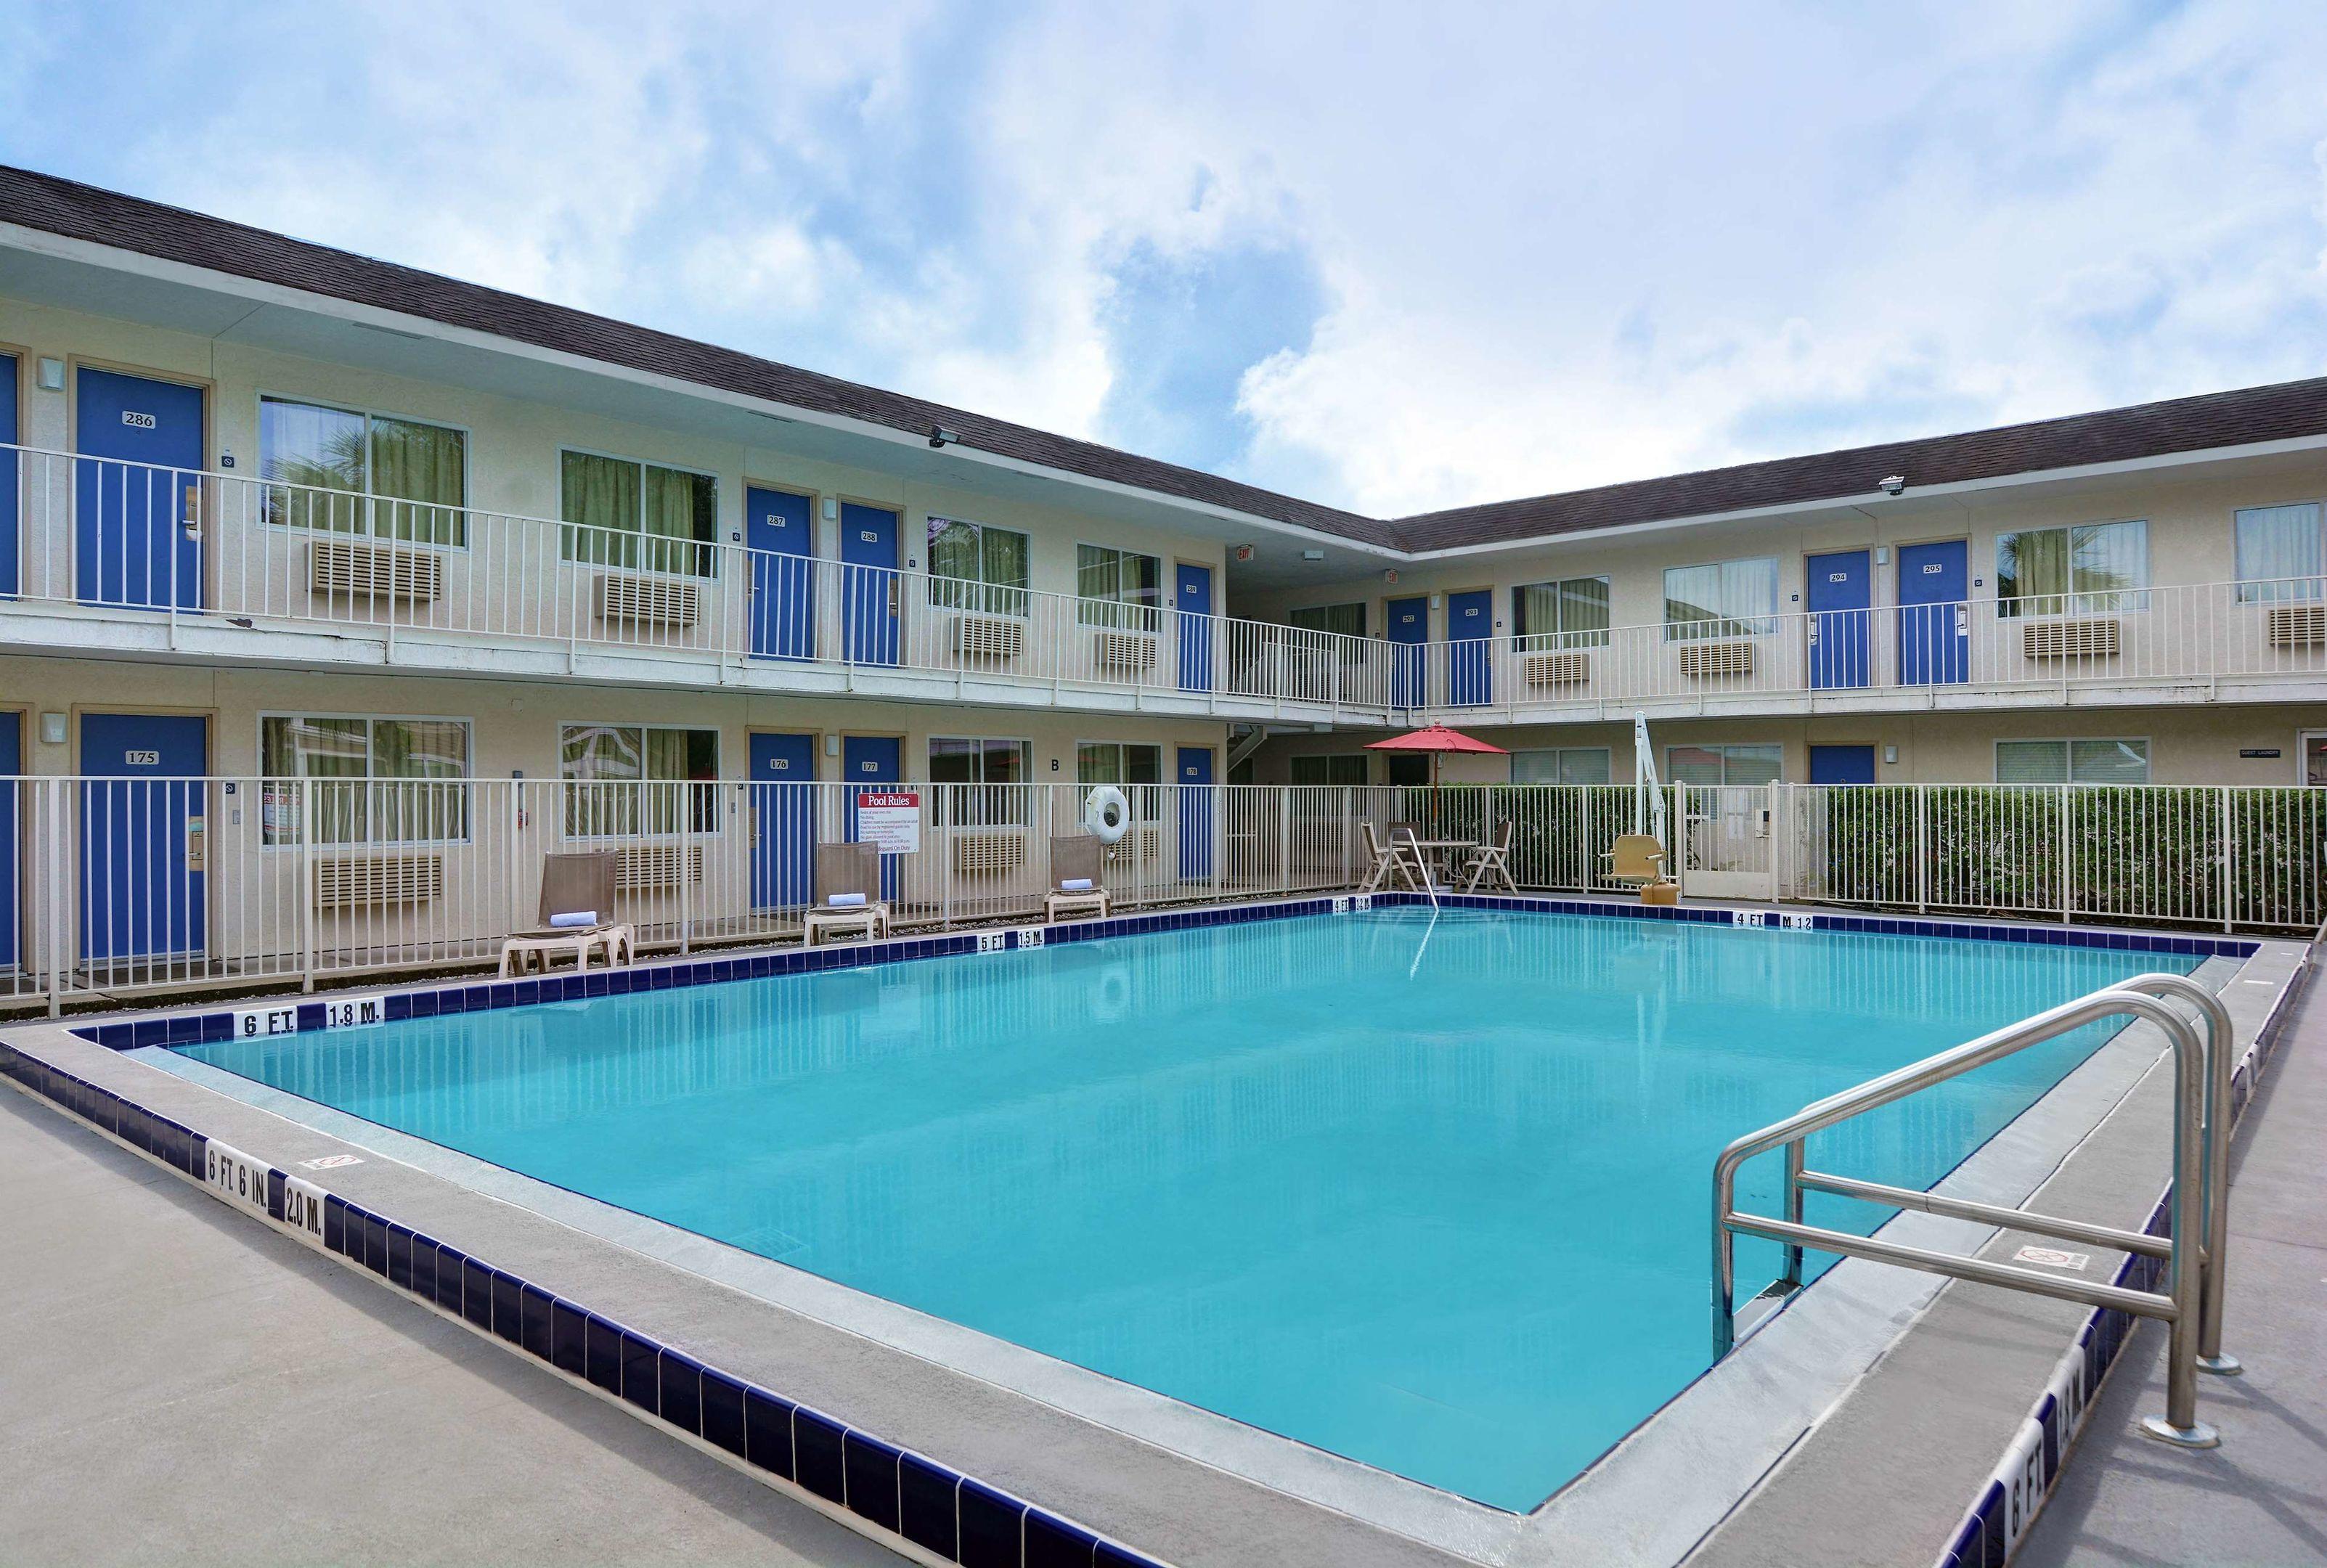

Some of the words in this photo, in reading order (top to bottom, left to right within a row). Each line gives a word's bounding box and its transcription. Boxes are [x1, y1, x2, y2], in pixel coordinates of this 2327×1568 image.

[126, 413, 152, 427] 286
[769, 516, 783, 525] 287
[863, 532, 876, 542] 288
[1239, 548, 1250, 559] EXIT
[129, 752, 155, 763] 175
[773, 760, 786, 769] 176
[1051, 759, 1059, 772] B
[868, 796, 887, 806] Pool
[888, 796, 910, 806] Rules
[1335, 901, 1339, 912] 4
[1737, 913, 1745, 926] 4
[1750, 914, 1763, 927] FT
[981, 936, 987, 952] 5
[1019, 932, 1030, 948] 1.5
[1033, 931, 1043, 947] M.
[244, 1015, 257, 1037] 6
[268, 1010, 294, 1036] FT.
[329, 1004, 354, 1028] 1.8
[360, 1001, 380, 1025] M.
[209, 1150, 216, 1180] 6
[221, 1155, 233, 1191] FT.
[239, 1164, 246, 1196] 6
[253, 1169, 266, 1208] IN.
[287, 1187, 303, 1228] 2.0
[307, 1196, 322, 1236] M.
[2012, 1477, 2020, 1538] 6
